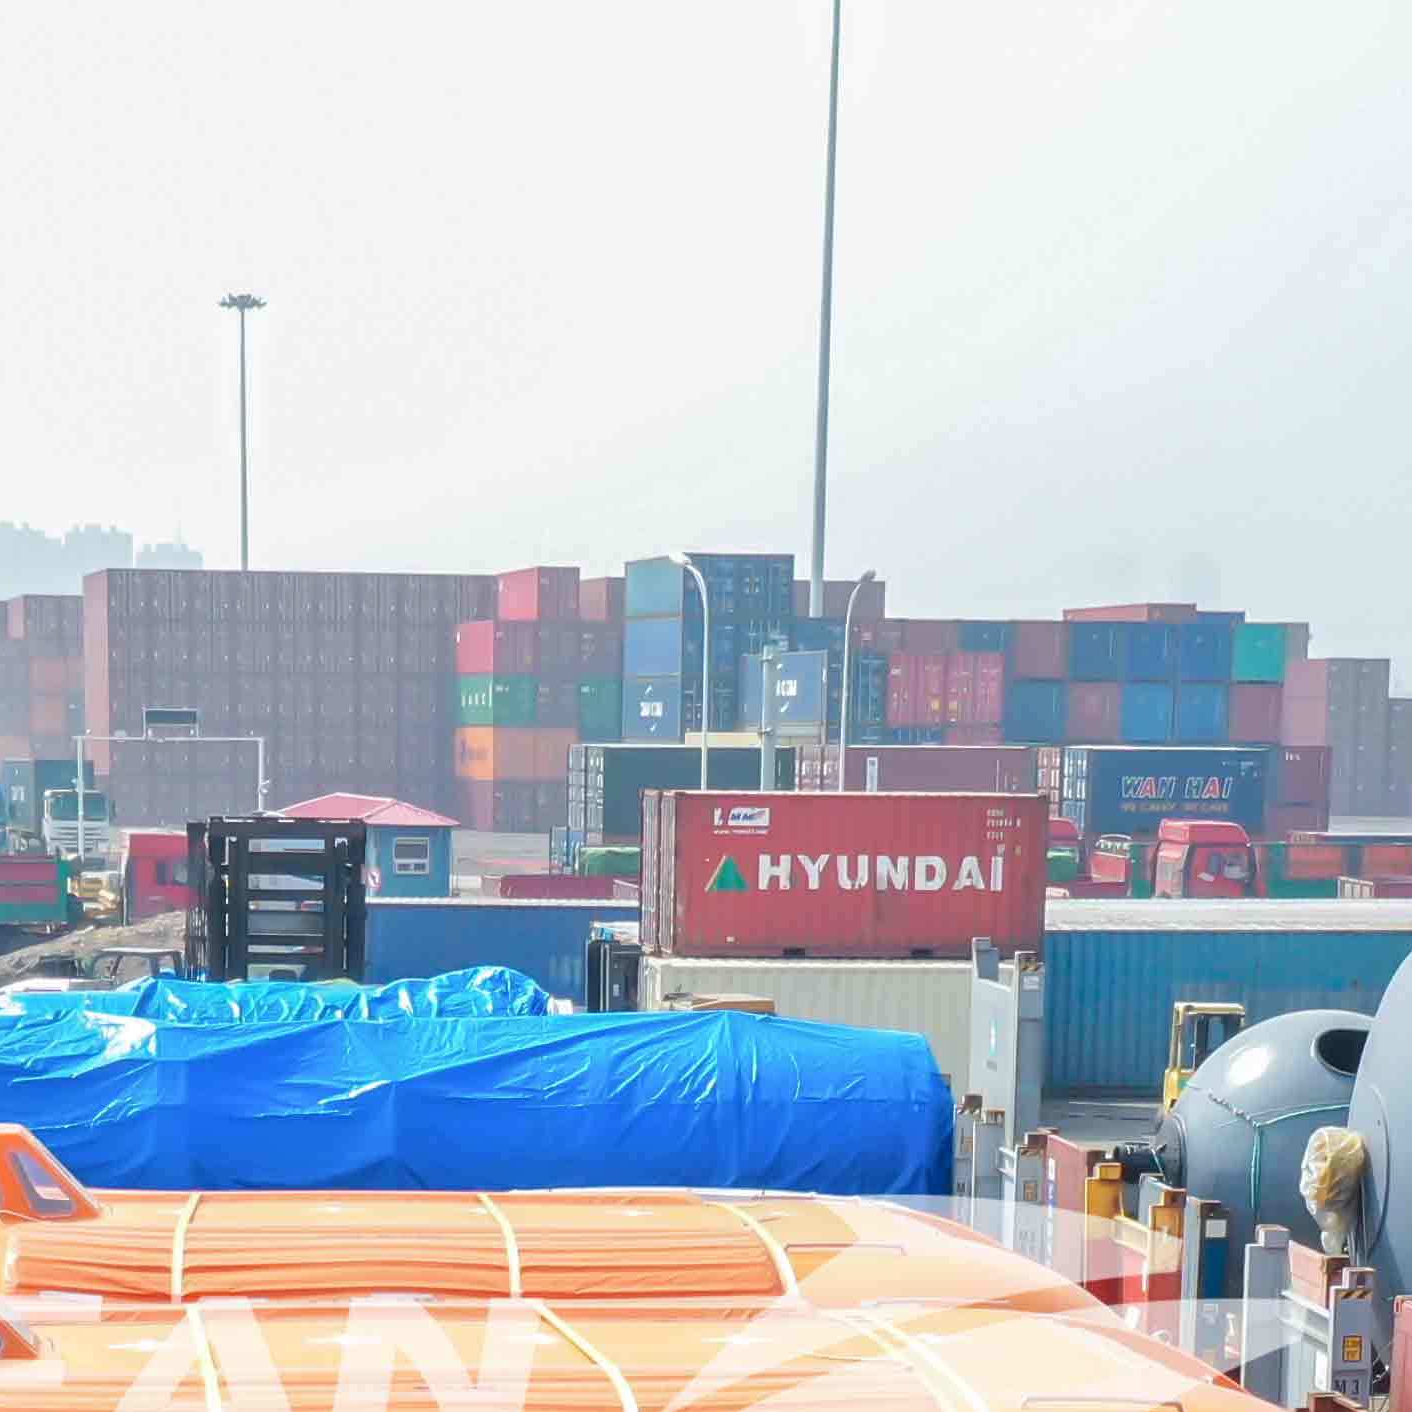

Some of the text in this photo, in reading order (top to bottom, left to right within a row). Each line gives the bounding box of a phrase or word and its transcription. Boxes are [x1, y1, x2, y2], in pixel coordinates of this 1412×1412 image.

[1120, 775, 1234, 799] WAN HAI
[758, 854, 1005, 891] HYUNDAI
